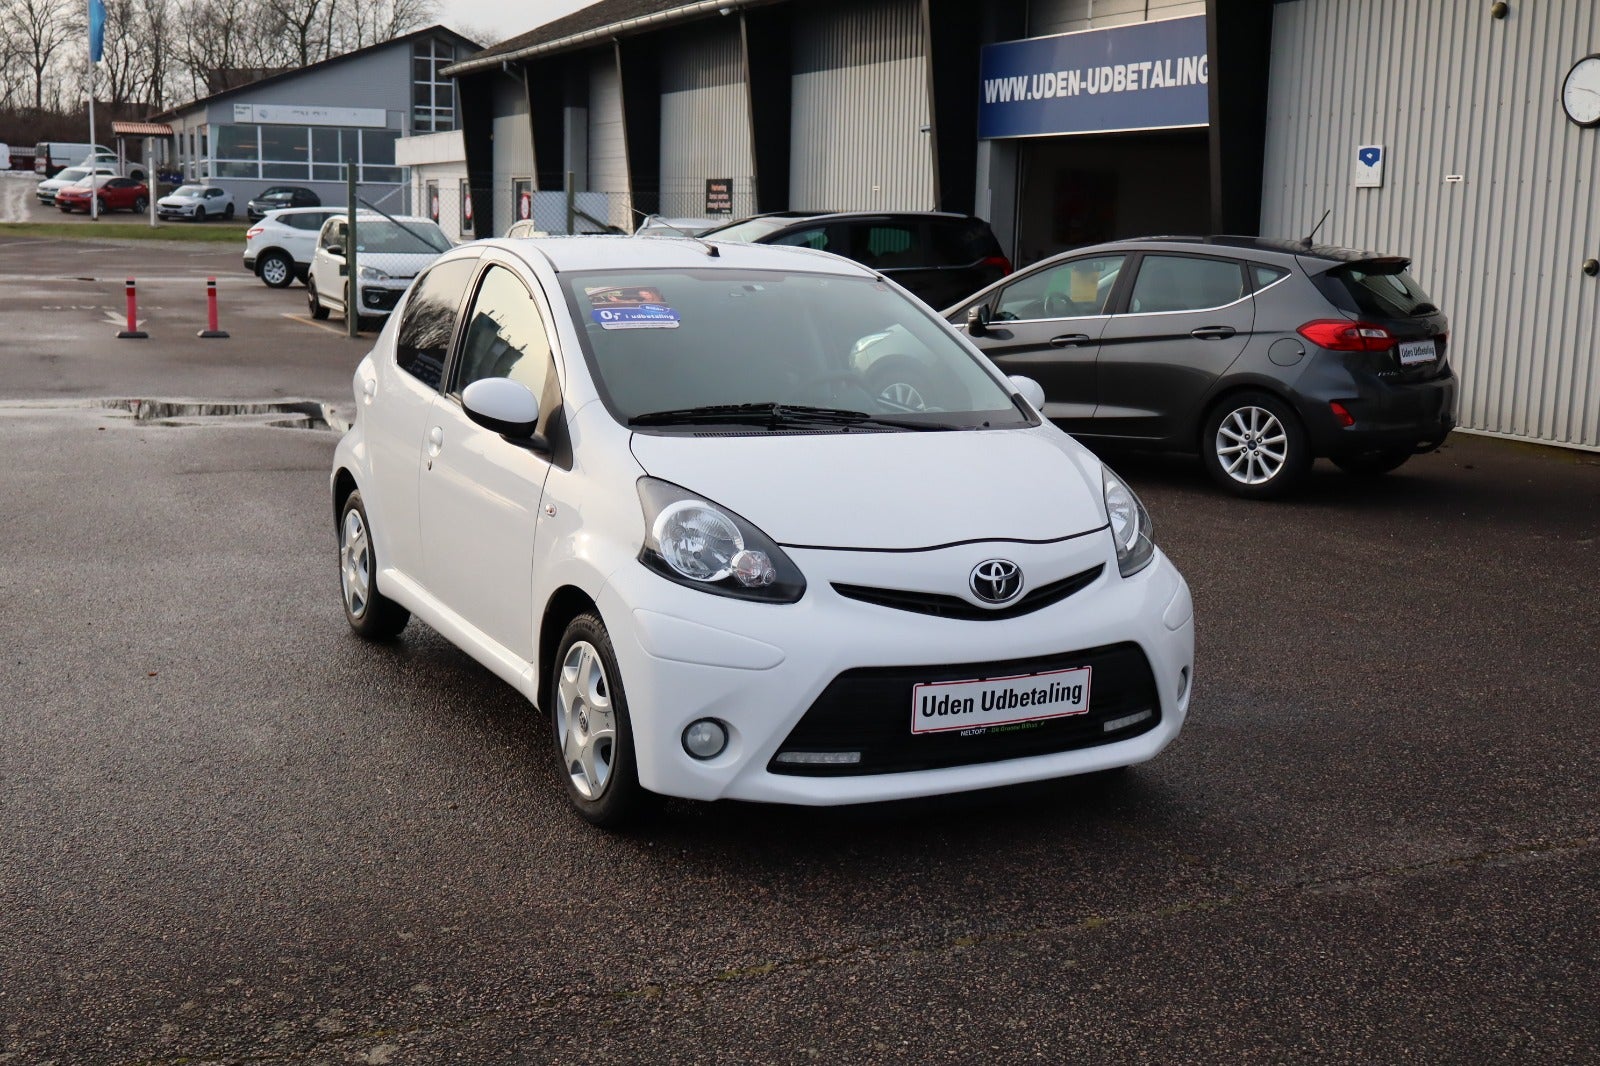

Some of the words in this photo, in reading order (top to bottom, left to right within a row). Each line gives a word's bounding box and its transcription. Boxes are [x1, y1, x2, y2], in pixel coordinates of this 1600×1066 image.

[922, 694, 974, 718] Uden
[981, 682, 1083, 712] Udbetaling
[960, 727, 987, 737] NELTOFT
